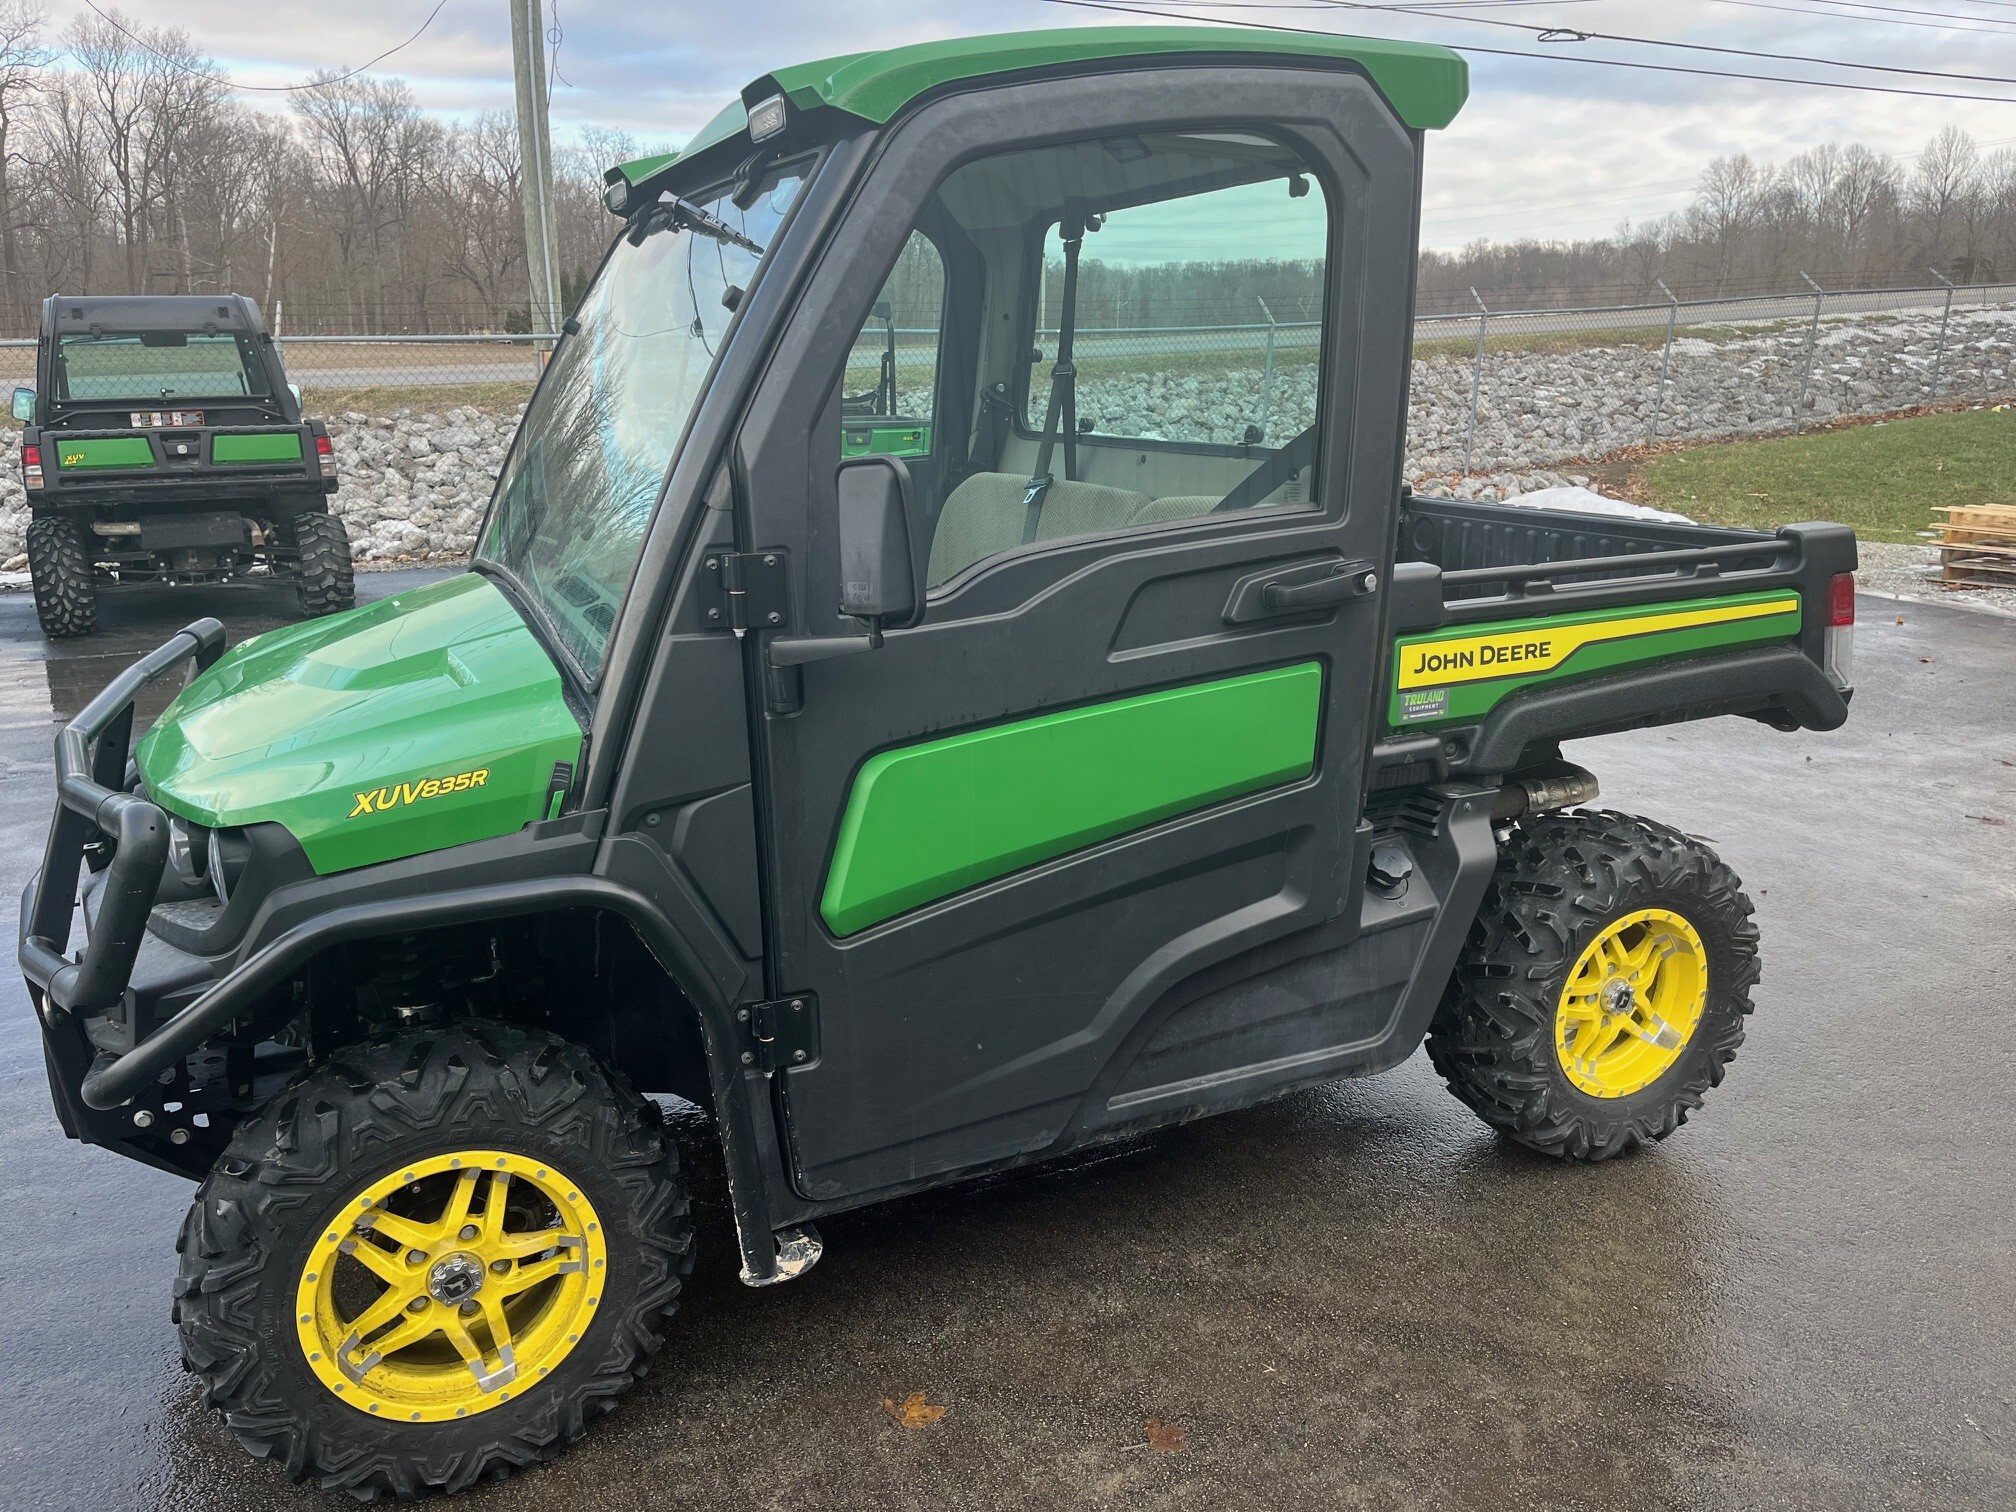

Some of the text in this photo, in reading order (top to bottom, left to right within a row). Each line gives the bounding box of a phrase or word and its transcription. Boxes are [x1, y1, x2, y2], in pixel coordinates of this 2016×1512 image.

[66, 453, 85, 461] XUV
[1414, 642, 1551, 674] JOHN DEERE
[1404, 690, 1444, 706] TRULAND
[1409, 702, 1439, 711] EQUIPMENT
[344, 768, 491, 819] XUV835R
